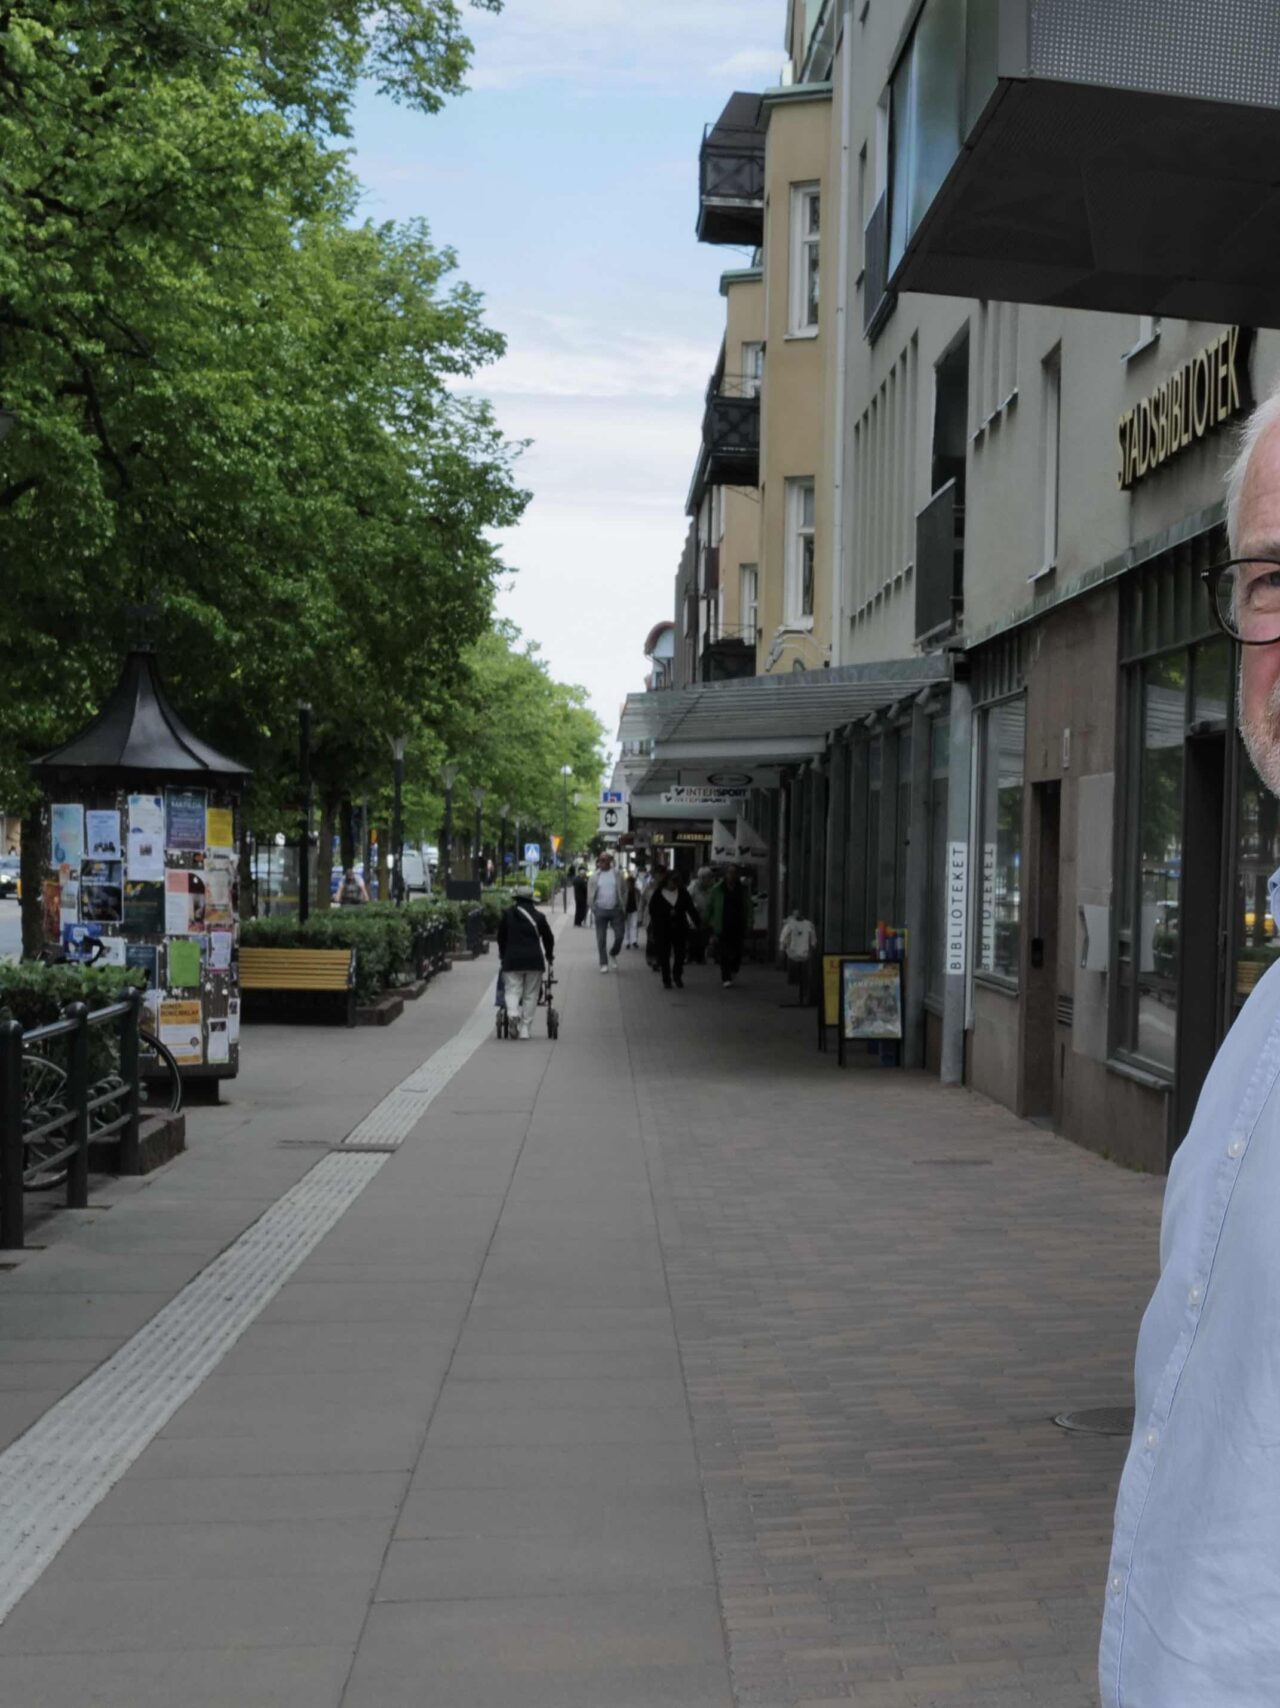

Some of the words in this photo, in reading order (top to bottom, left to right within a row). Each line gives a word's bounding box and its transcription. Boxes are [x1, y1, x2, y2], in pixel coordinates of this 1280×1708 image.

[1116, 325, 1240, 490] STADSBIBLIOTEK
[686, 787, 747, 797] INTERSPORT
[950, 848, 964, 970] BIBLIOTEKET
